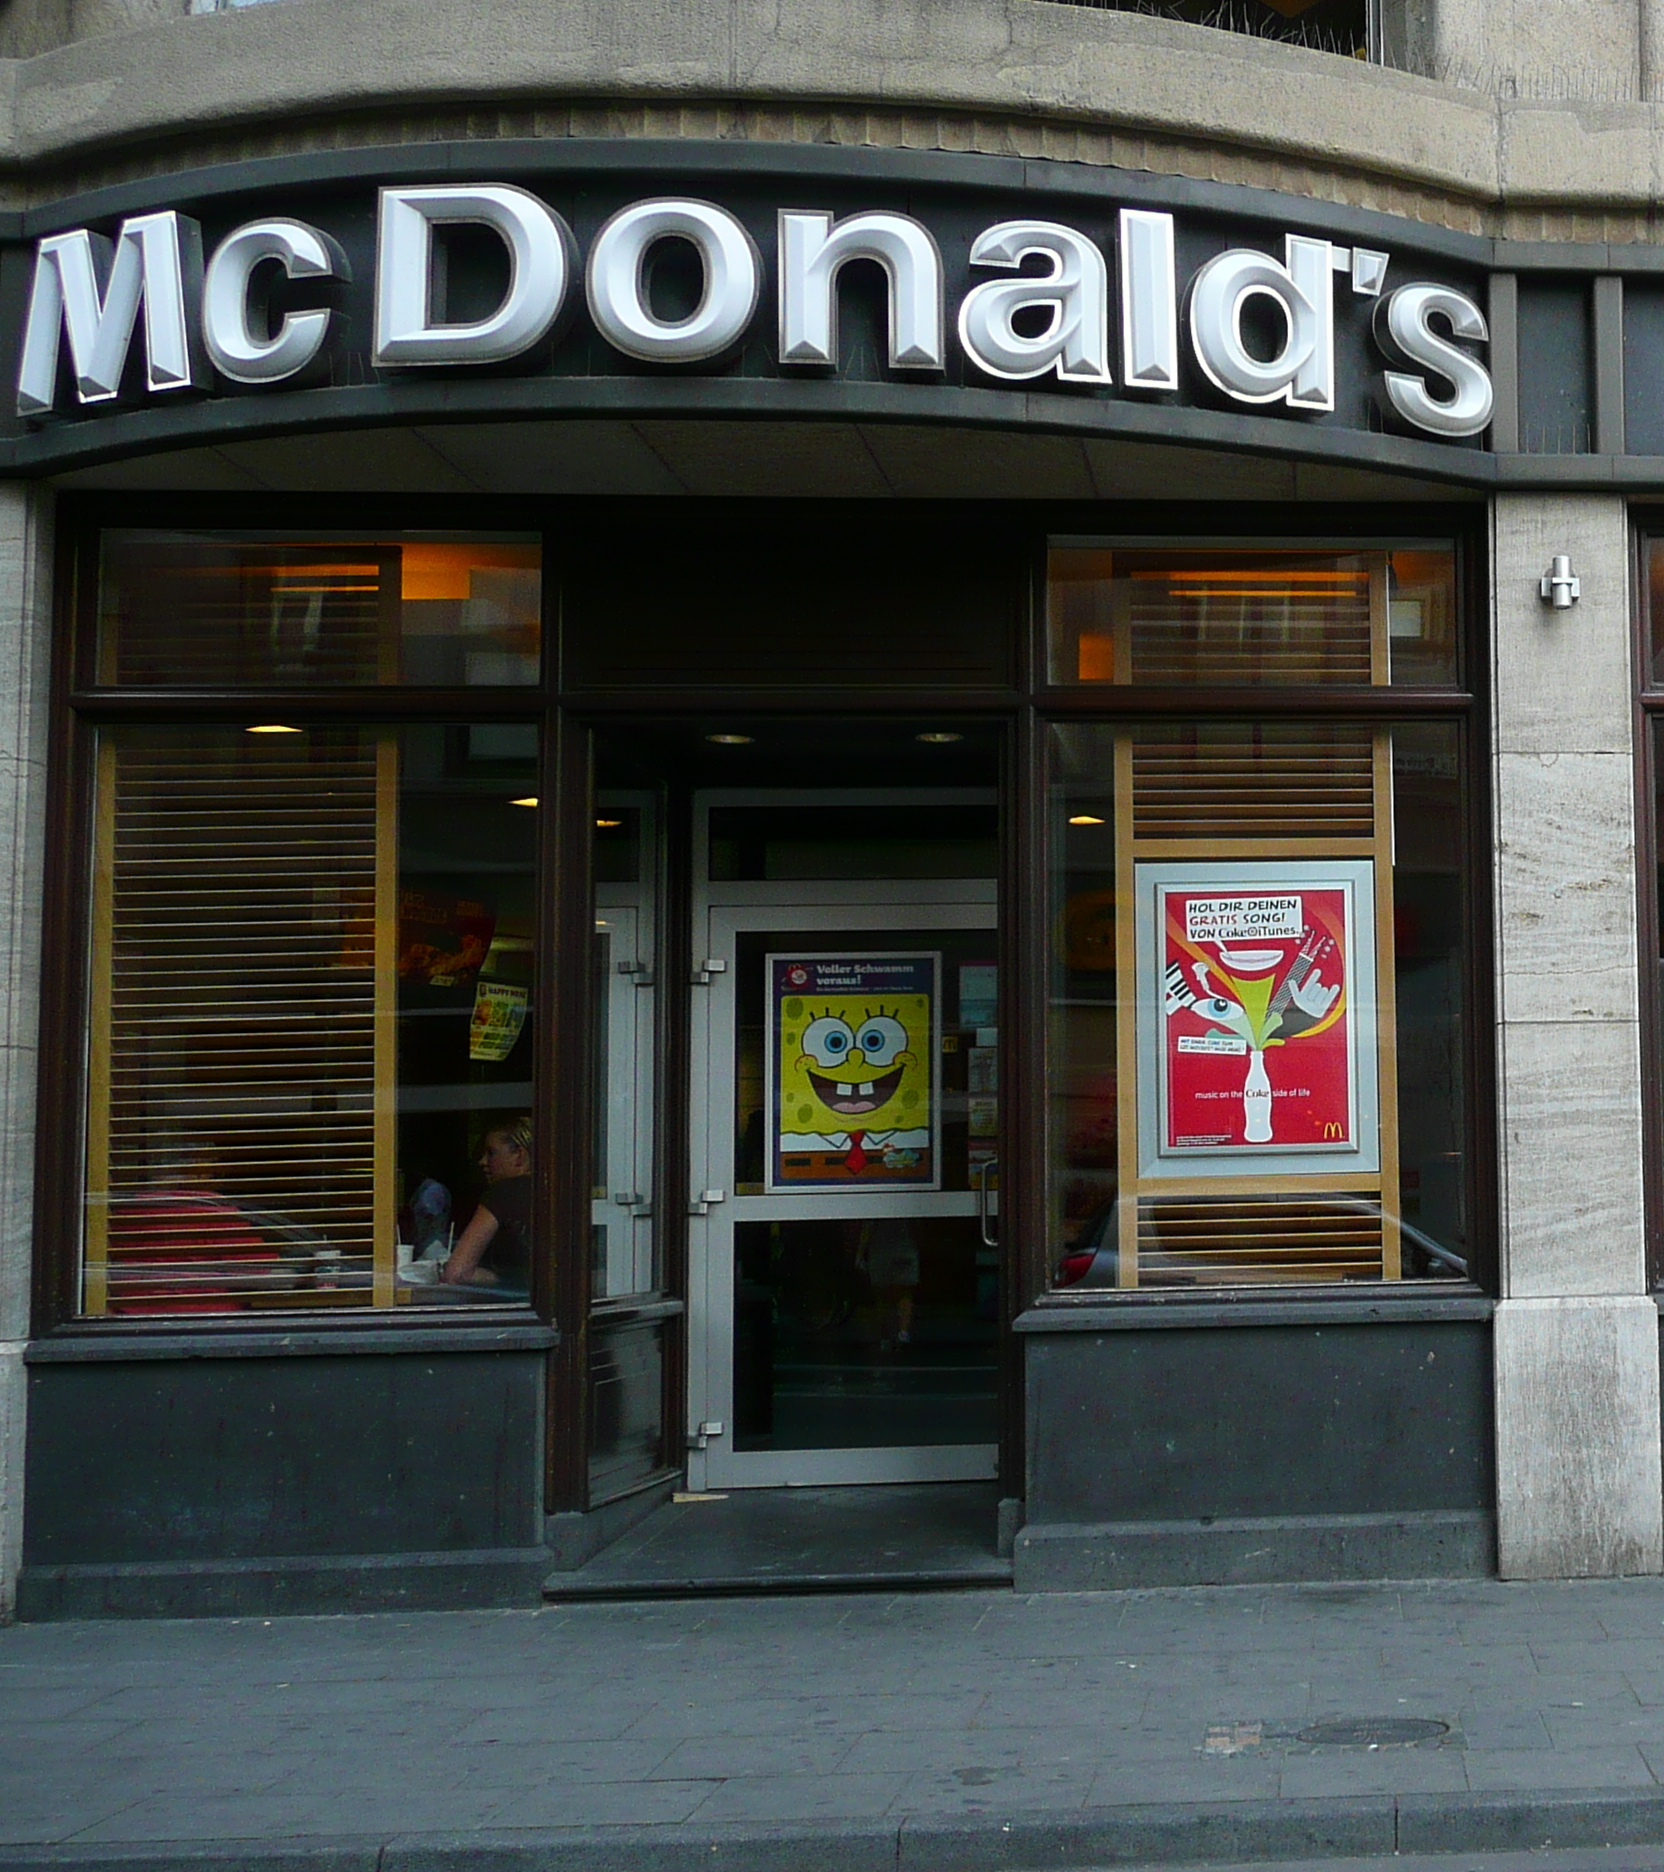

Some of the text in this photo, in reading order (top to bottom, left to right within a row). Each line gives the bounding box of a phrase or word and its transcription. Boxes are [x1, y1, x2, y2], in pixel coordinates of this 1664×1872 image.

[16, 182, 1494, 437] McDonald's
[1188, 899, 1297, 913] HOL DIR DEINEN
[1189, 912, 1285, 926] GRATIS SONG!
[1190, 928, 1216, 939] VON
[816, 963, 914, 974] Voller Schwamm
[816, 975, 861, 985] voraus!
[1195, 1091, 1218, 1099] music
[1230, 1090, 1243, 1099] the
[1246, 1089, 1269, 1098] Coke
[1272, 1089, 1288, 1097] side
[1289, 1088, 1297, 1097] of
[1298, 1088, 1310, 1097] life
